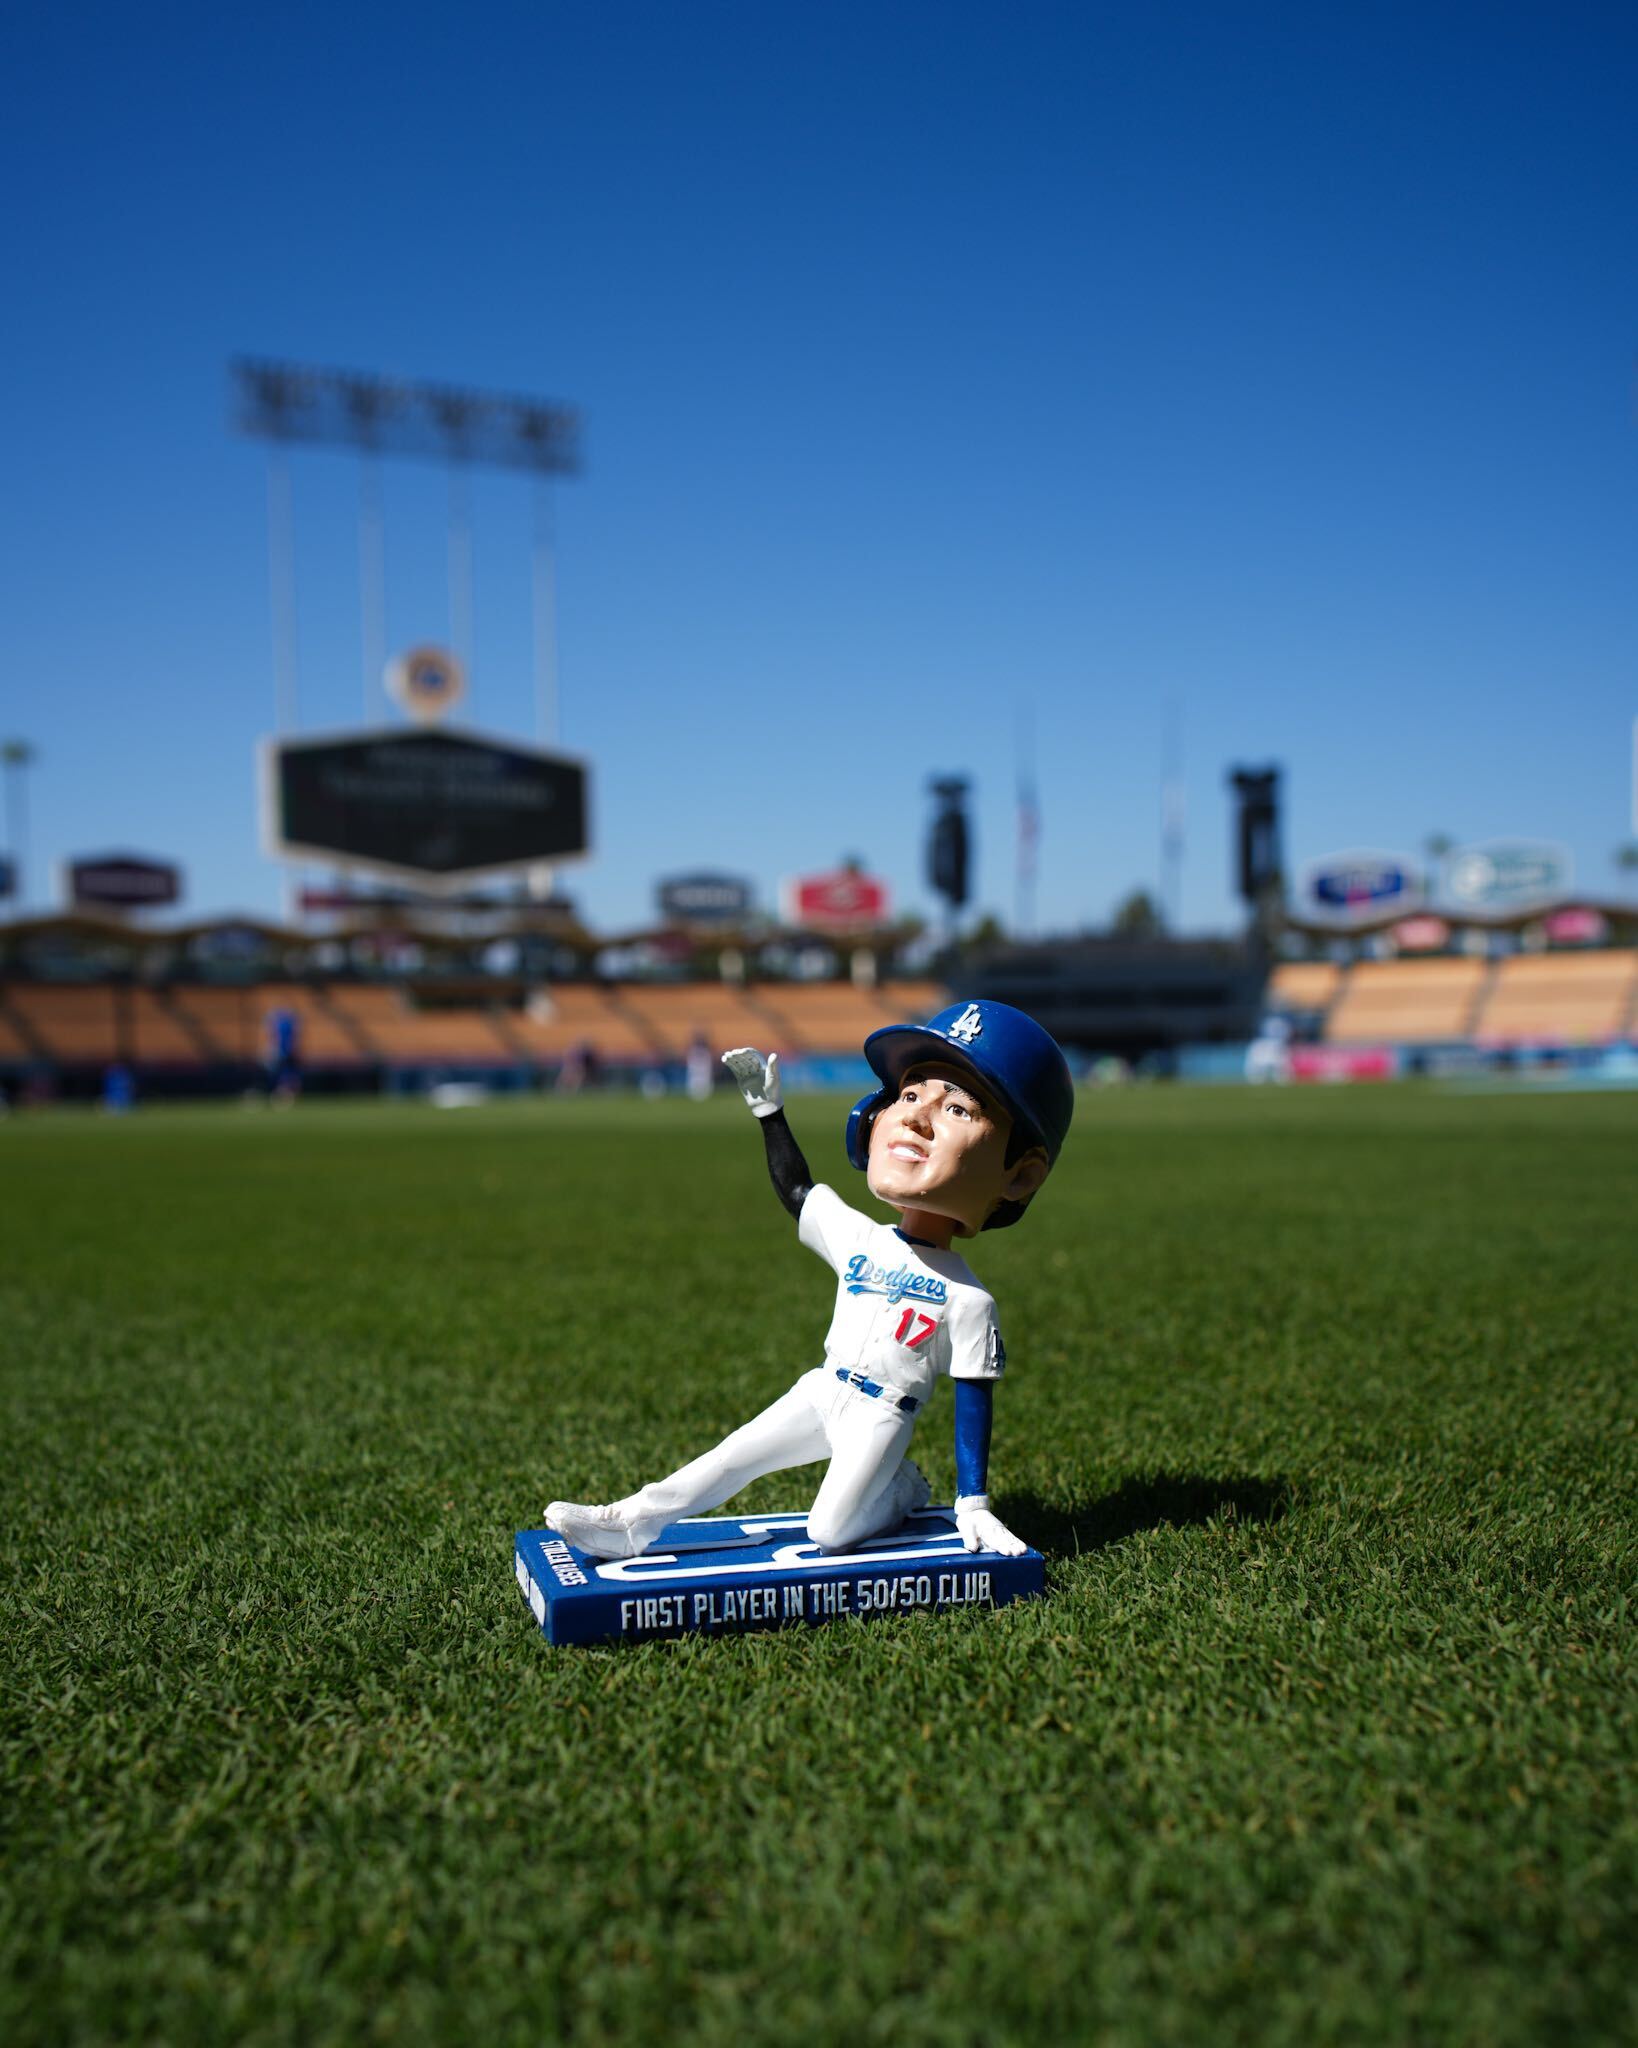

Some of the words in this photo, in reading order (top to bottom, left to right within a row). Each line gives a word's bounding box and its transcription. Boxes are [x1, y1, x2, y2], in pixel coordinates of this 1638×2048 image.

[949, 1003, 982, 1042] LA
[844, 1254, 947, 1304] Dodgers
[894, 1307, 938, 1349] 17
[538, 1539, 575, 1565] STOLEN
[551, 1562, 589, 1586] BASES
[620, 1595, 686, 1630] FIRST
[693, 1587, 777, 1625] PLAYER
[783, 1585, 804, 1617] IN
[809, 1581, 851, 1614] THE
[857, 1575, 932, 1612] 50/50
[938, 1571, 992, 1604] CLUB
